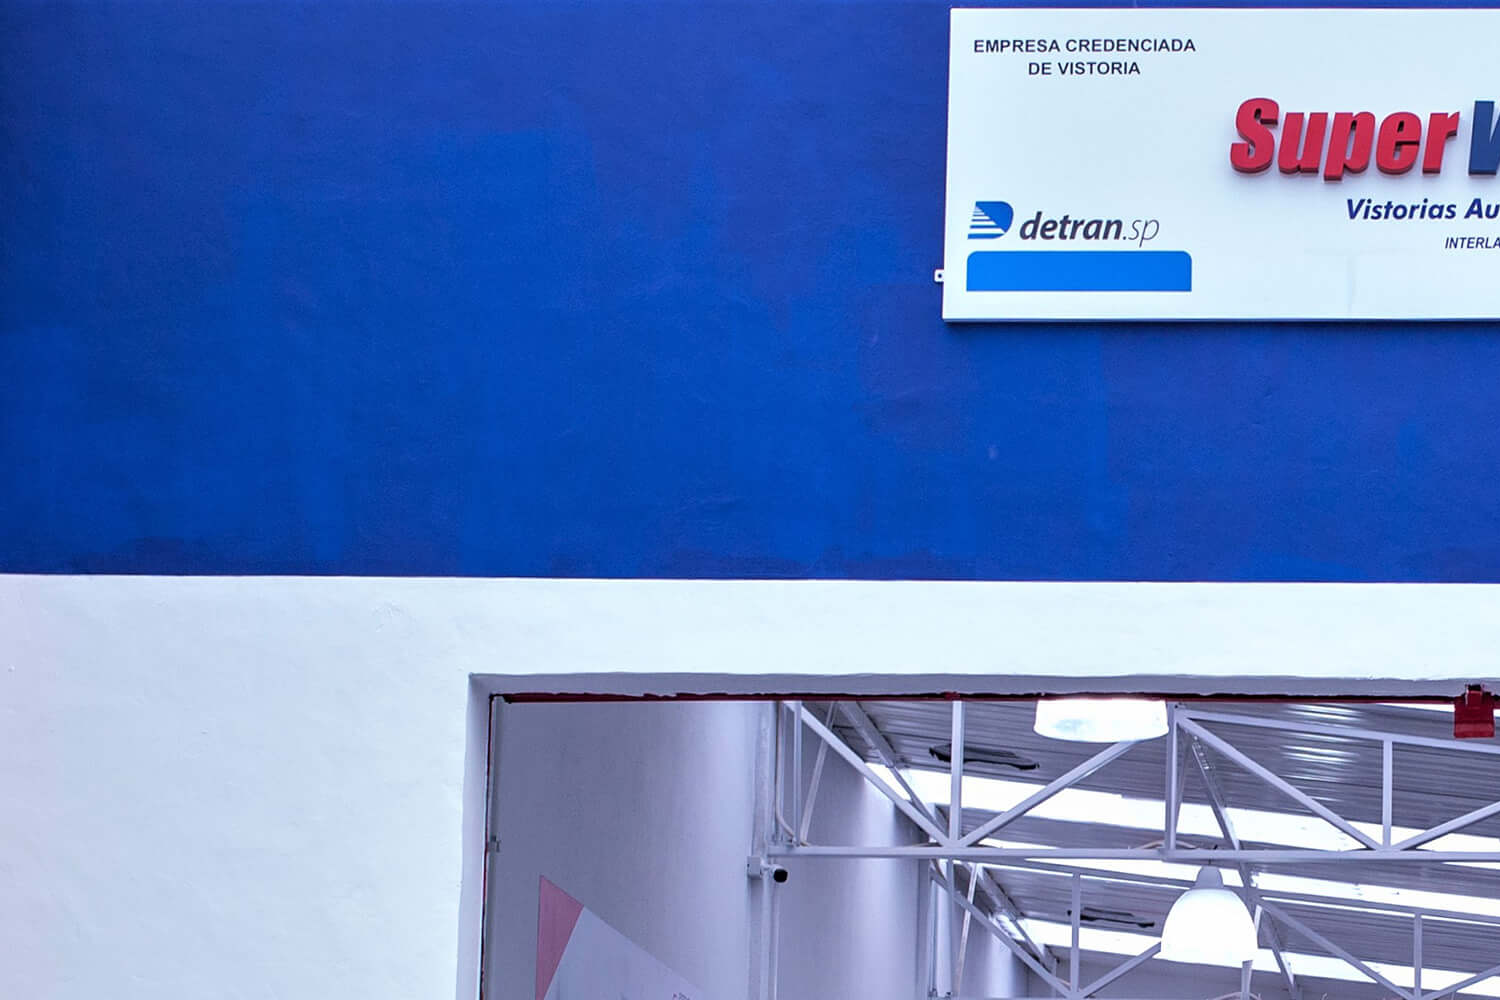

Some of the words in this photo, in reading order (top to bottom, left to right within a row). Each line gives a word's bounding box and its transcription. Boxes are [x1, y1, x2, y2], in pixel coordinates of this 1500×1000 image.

[973, 39, 1061, 53] EMPRESA
[1065, 38, 1196, 53] CREDENCIADA
[1028, 62, 1052, 76] DE
[1057, 61, 1141, 76] VISTORIA
[1230, 97, 1460, 181] Super
[1346, 198, 1457, 221] Vistorias
[1019, 210, 1160, 248] detran.sp
